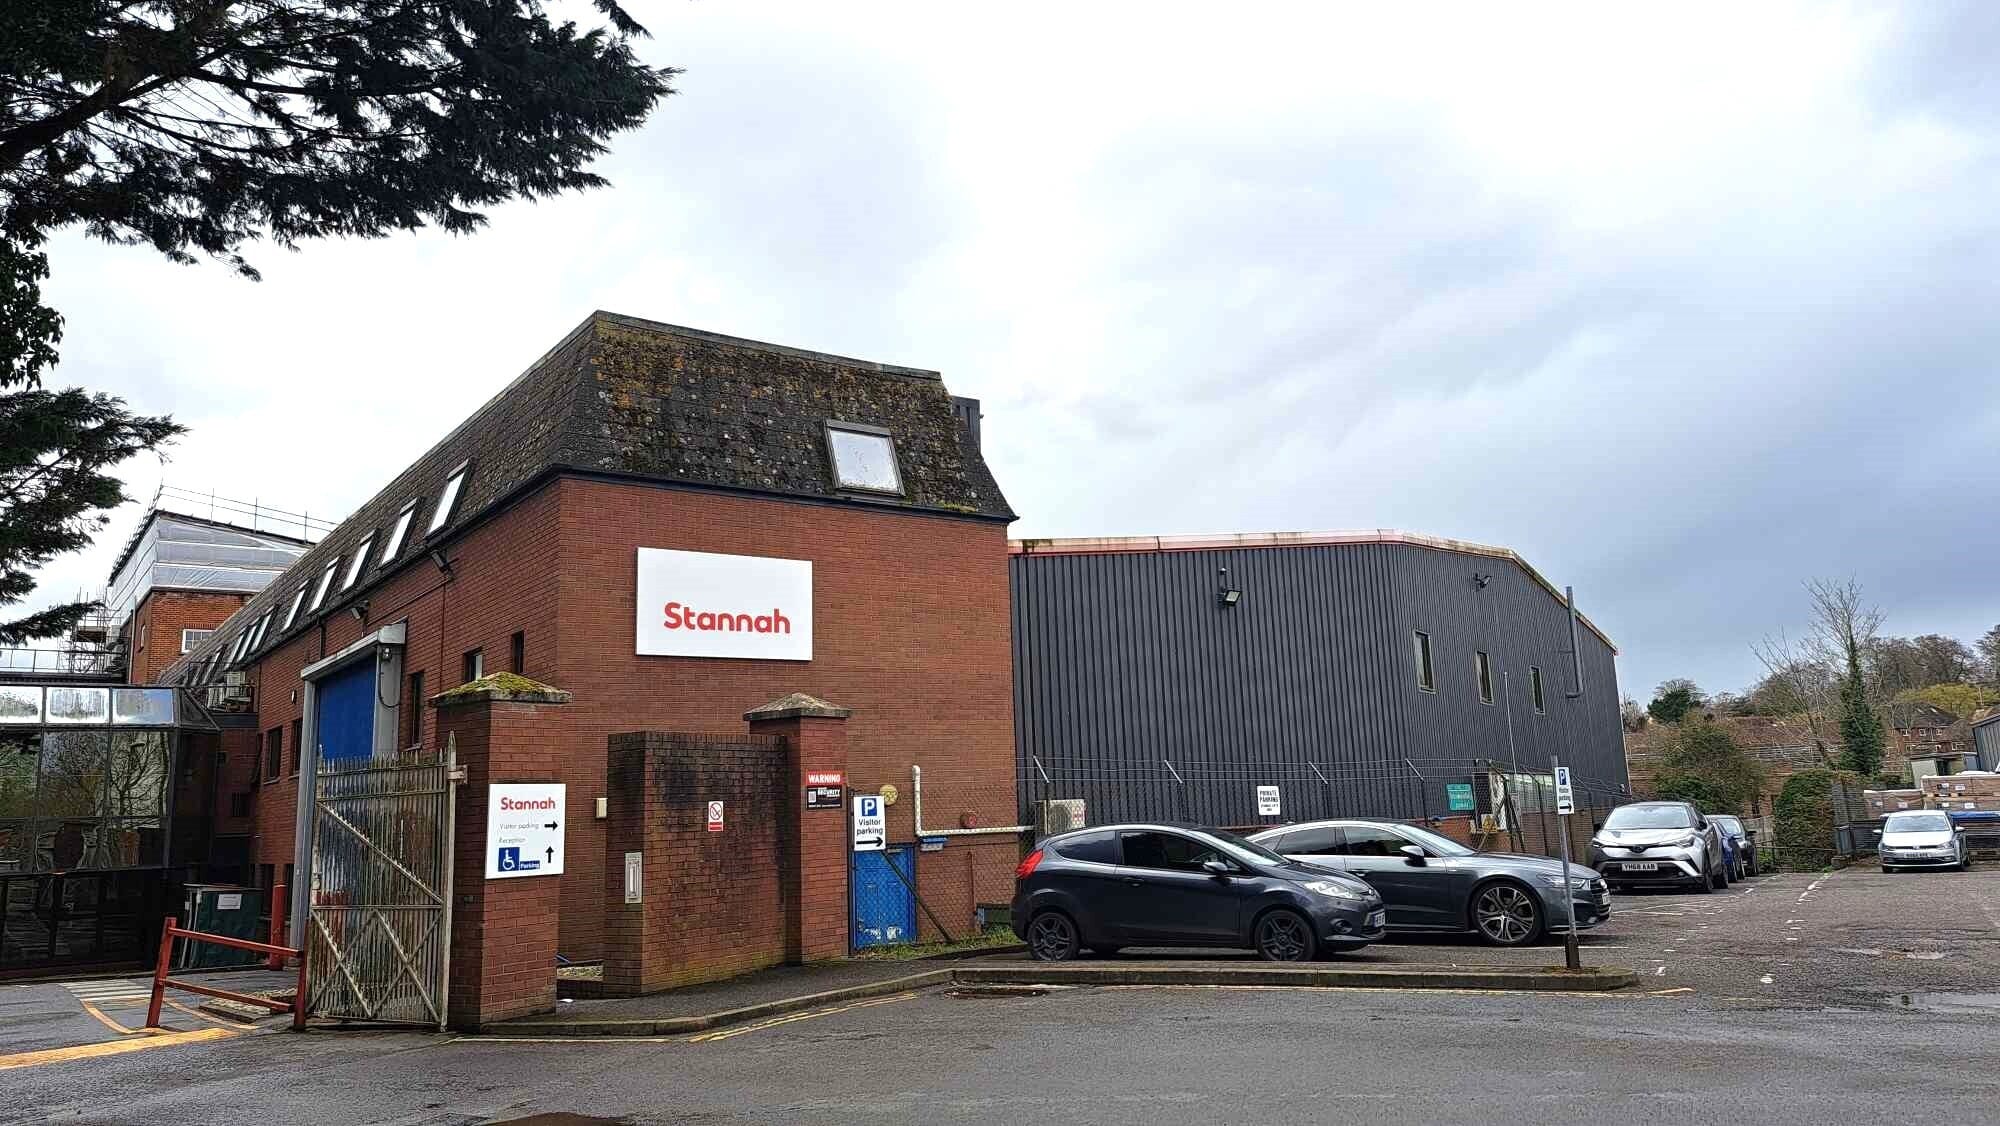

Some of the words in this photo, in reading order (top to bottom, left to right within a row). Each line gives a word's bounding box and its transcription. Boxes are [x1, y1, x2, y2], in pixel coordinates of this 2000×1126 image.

[664, 602, 791, 634] Stannah
[808, 774, 840, 783] WARNING
[501, 797, 556, 810] Stannah
[864, 799, 875, 815] P
[857, 828, 883, 836] parking
